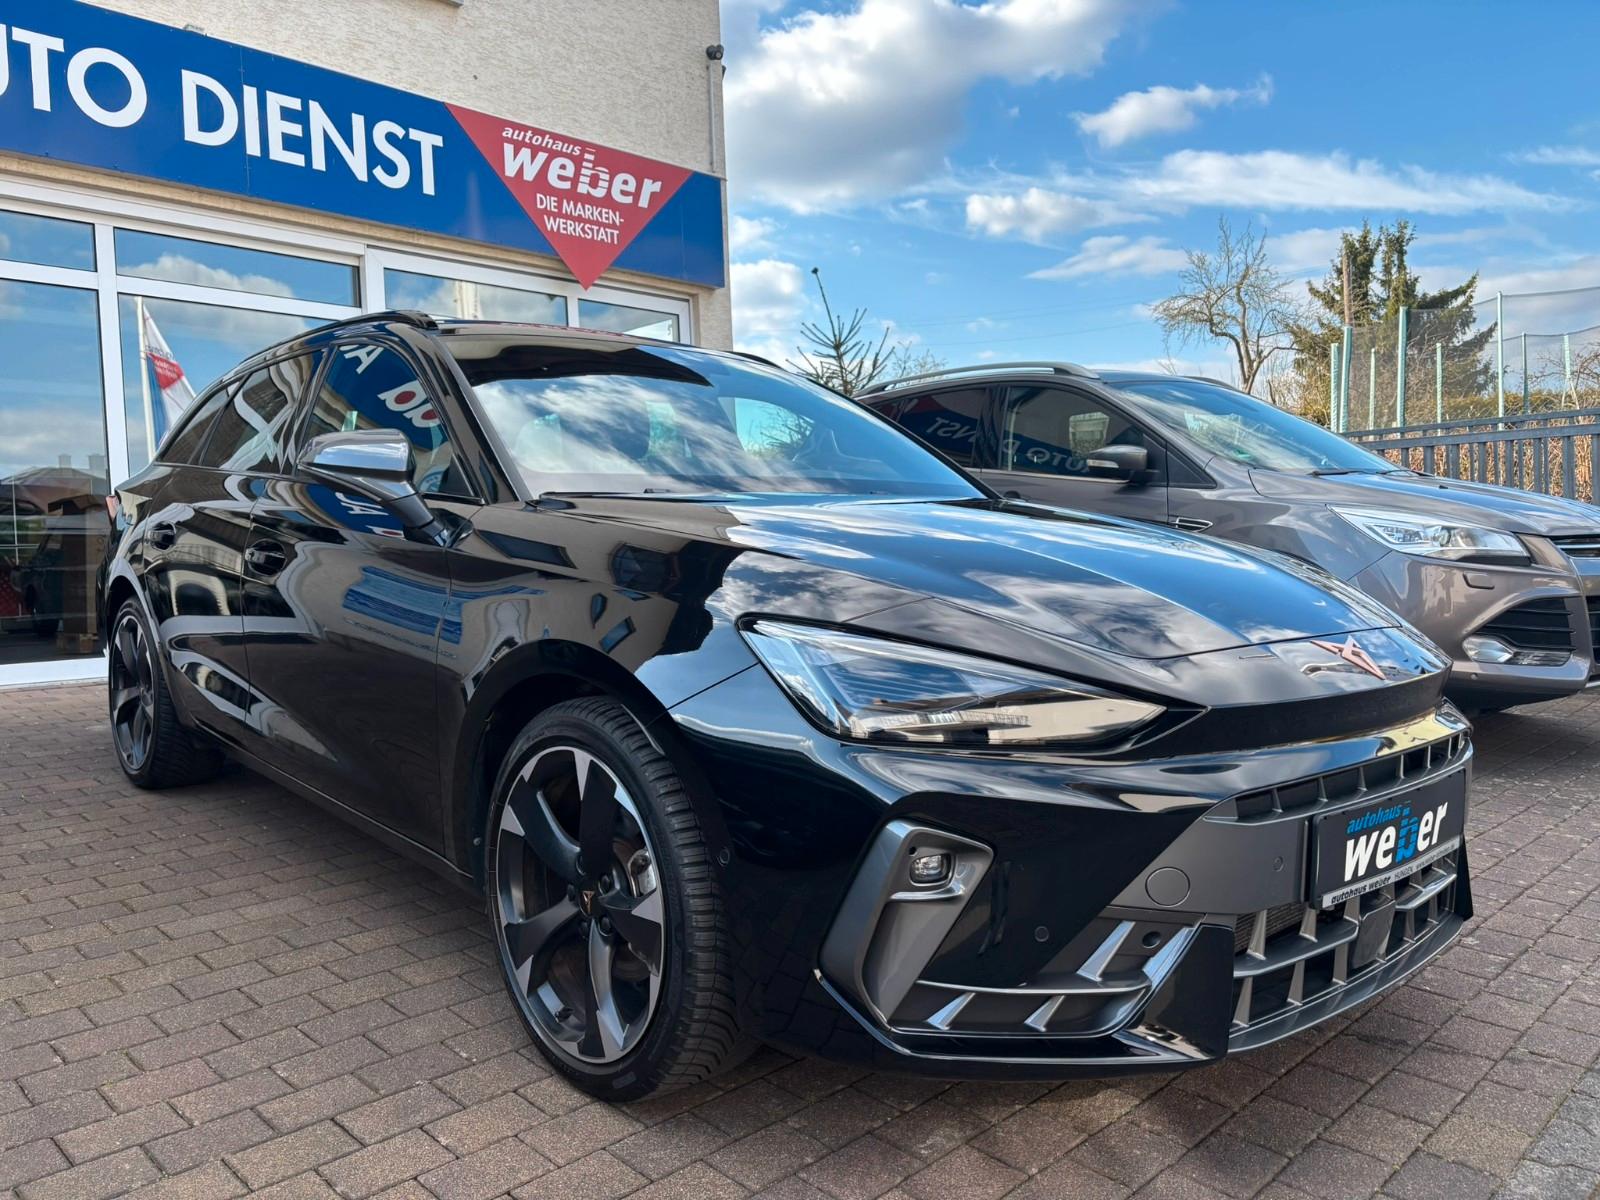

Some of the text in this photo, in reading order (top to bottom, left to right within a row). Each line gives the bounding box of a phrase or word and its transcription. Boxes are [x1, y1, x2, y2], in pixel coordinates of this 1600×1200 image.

[0, 24, 444, 196] TO DIENST
[502, 127, 581, 156] autohaus
[503, 142, 662, 208] weber
[536, 193, 624, 226] DIE MARKEN-
[544, 215, 619, 245] WERKSTATT
[1347, 805, 1402, 834] autohaus
[1344, 801, 1448, 882] weber
[1331, 884, 1367, 905] autohaus
